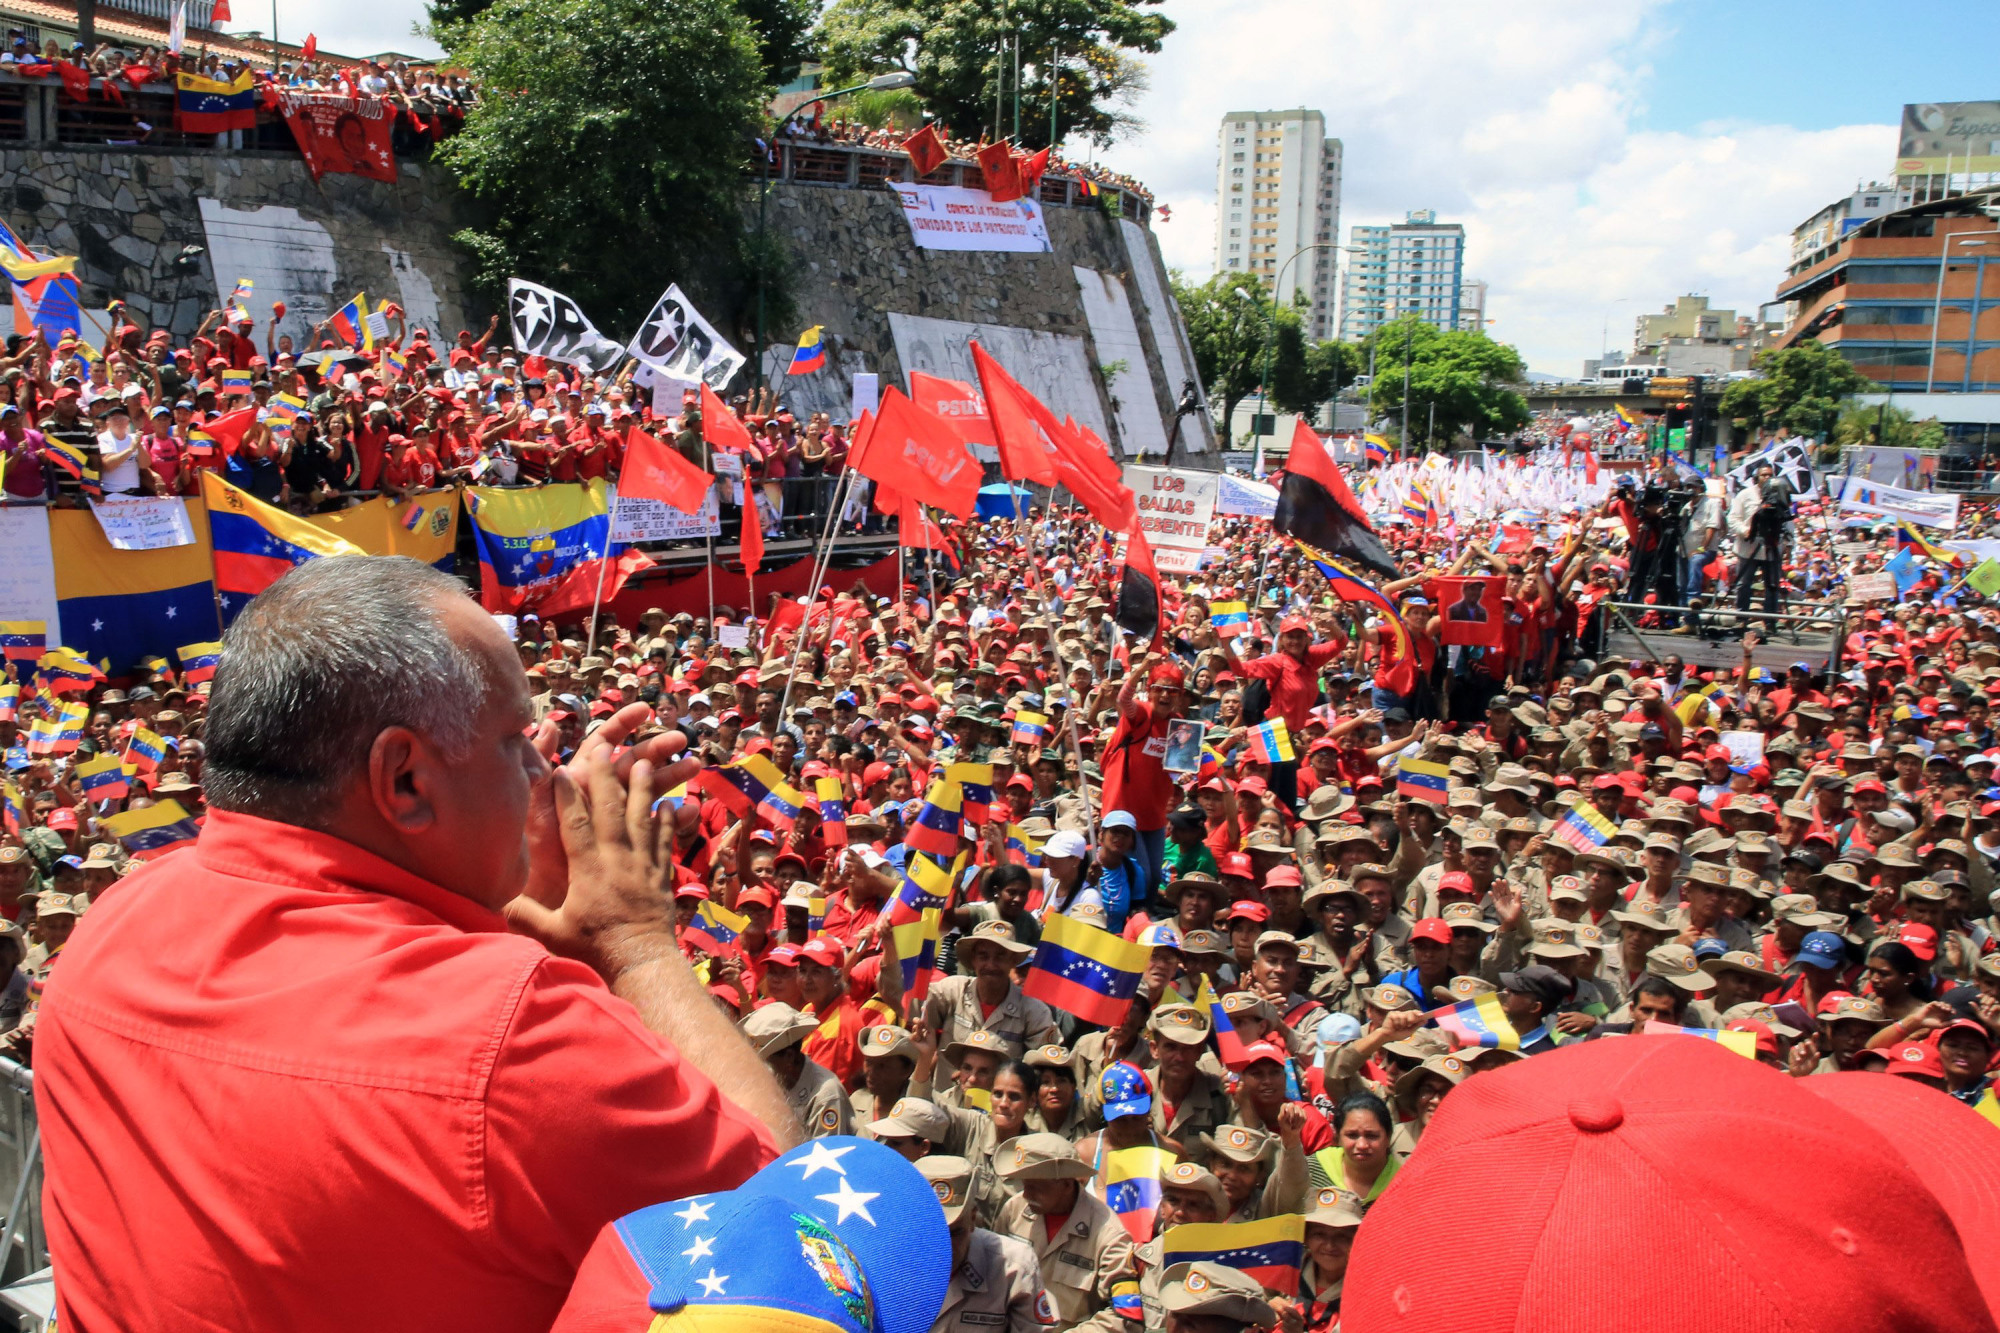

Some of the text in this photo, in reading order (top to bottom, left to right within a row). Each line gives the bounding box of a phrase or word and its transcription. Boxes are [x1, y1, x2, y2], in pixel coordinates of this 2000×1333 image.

[954, 220, 967, 233] DE
[1153, 475, 1185, 493] LOS
[1138, 494, 1196, 516] SALIAS
[677, 519, 701, 528] MADRE
[1137, 515, 1206, 537] RESENTE
